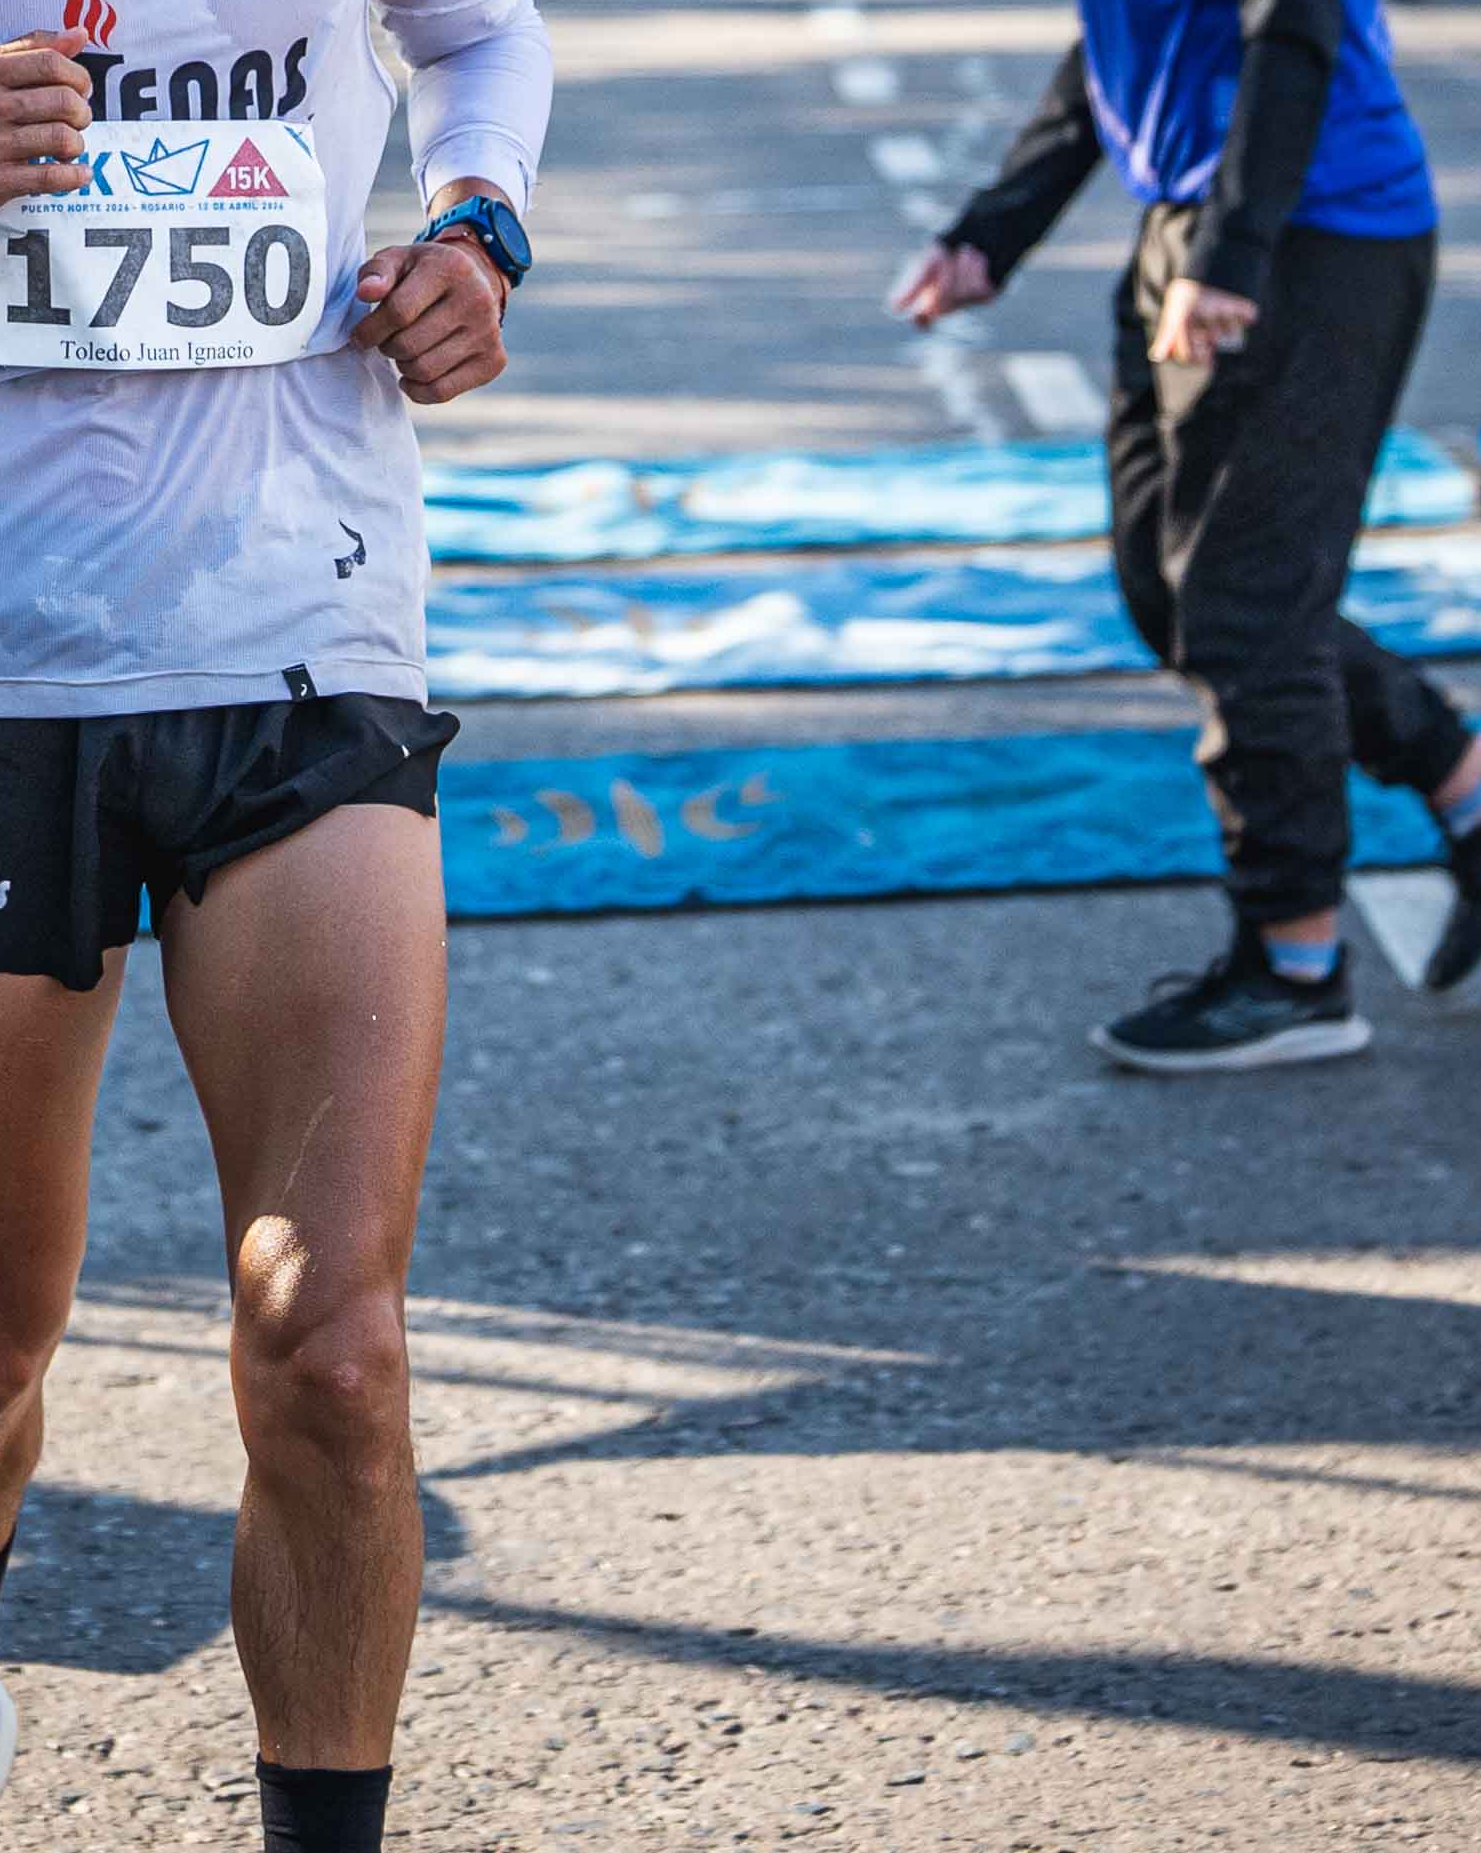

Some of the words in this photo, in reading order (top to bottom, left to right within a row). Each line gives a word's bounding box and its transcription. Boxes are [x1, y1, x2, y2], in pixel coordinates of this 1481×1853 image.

[72, 36, 308, 122] TENAS
[226, 165, 272, 190] 15K
[21, 204, 64, 214] PUERTO
[67, 204, 102, 213] NORTE
[105, 204, 130, 213] 2026
[140, 203, 186, 213] ROSARIO
[228, 201, 259, 211] ABRIL
[7, 224, 311, 328] 1750
[60, 340, 131, 362] Toledo
[137, 342, 180, 362] Juan
[187, 339, 254, 365] Ignacio
